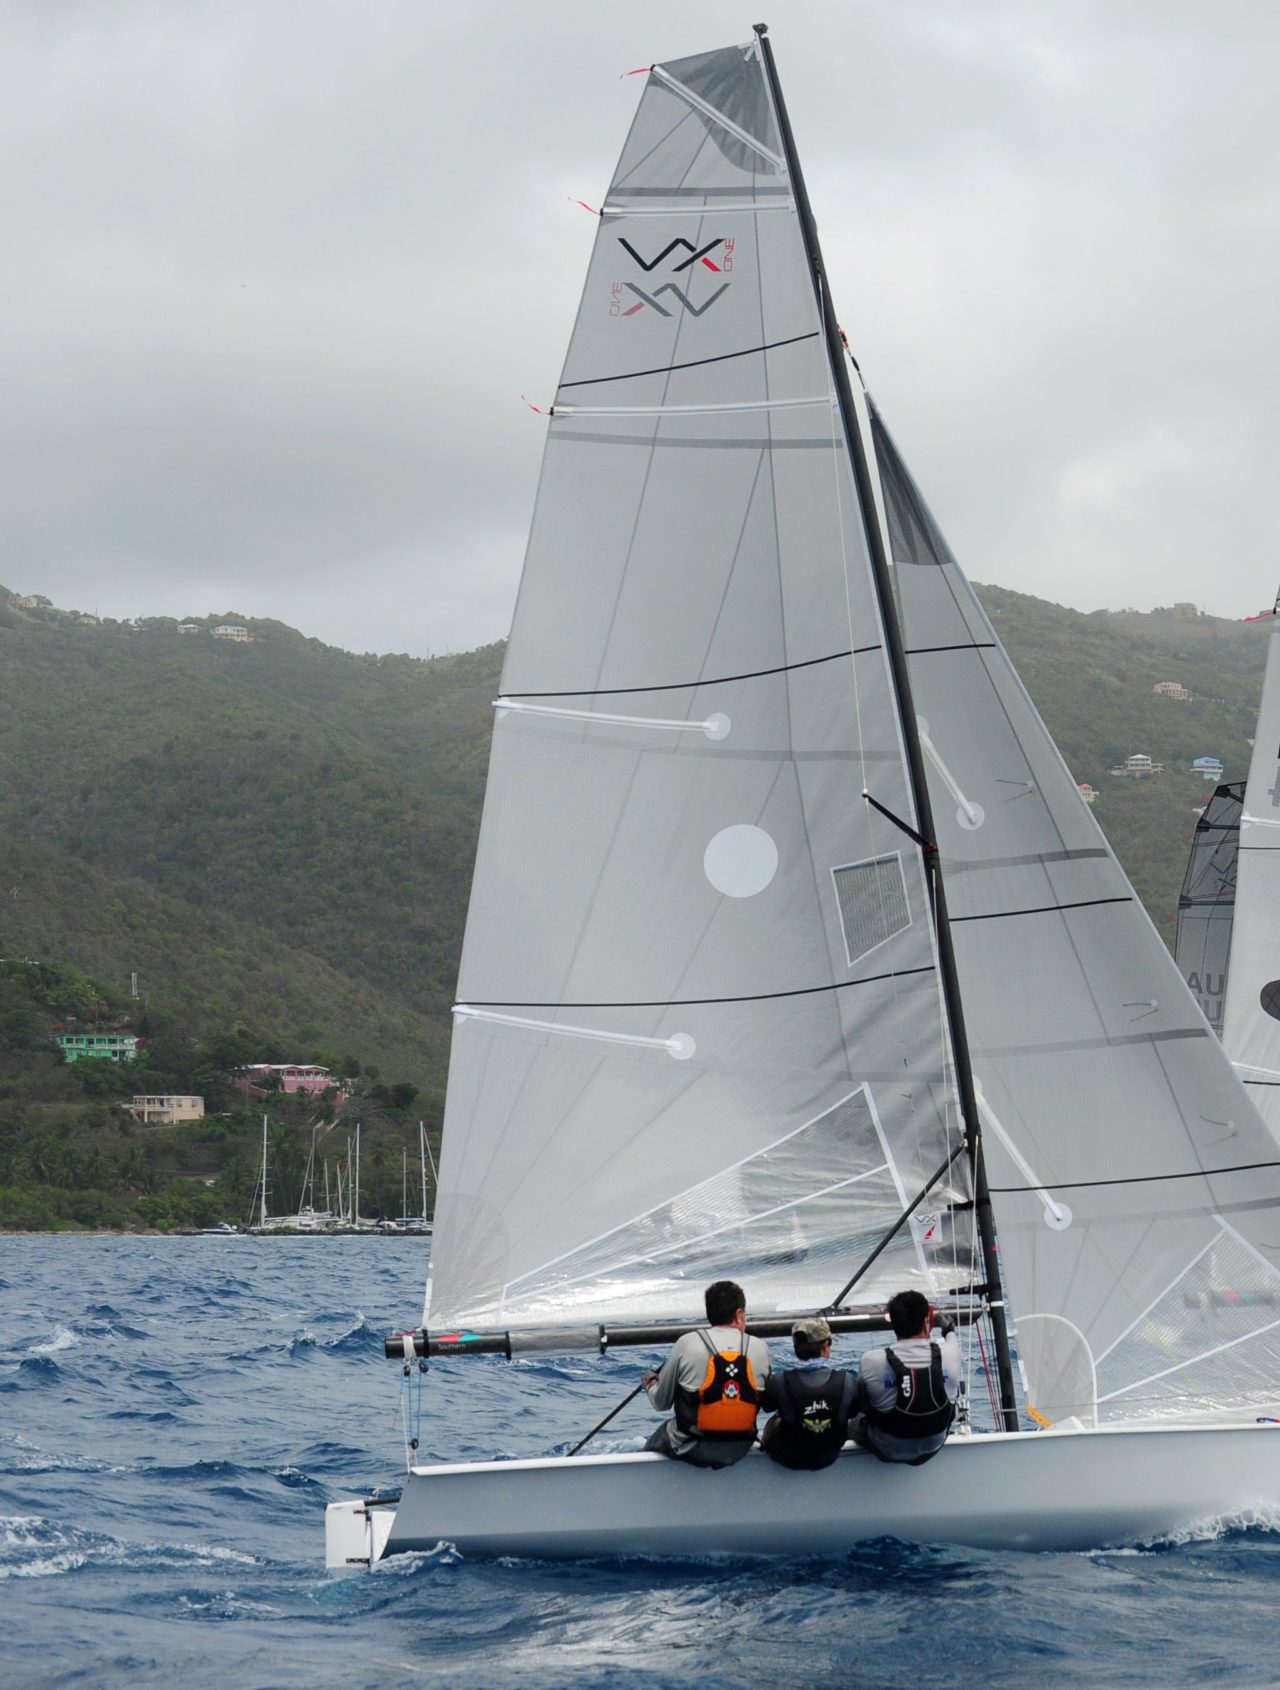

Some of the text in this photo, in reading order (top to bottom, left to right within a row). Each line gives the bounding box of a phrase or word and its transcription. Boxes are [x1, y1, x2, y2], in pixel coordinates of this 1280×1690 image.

[617, 237, 735, 272] VX ONE
[901, 1375, 911, 1397] Gill
[803, 1400, 830, 1416] zhik
